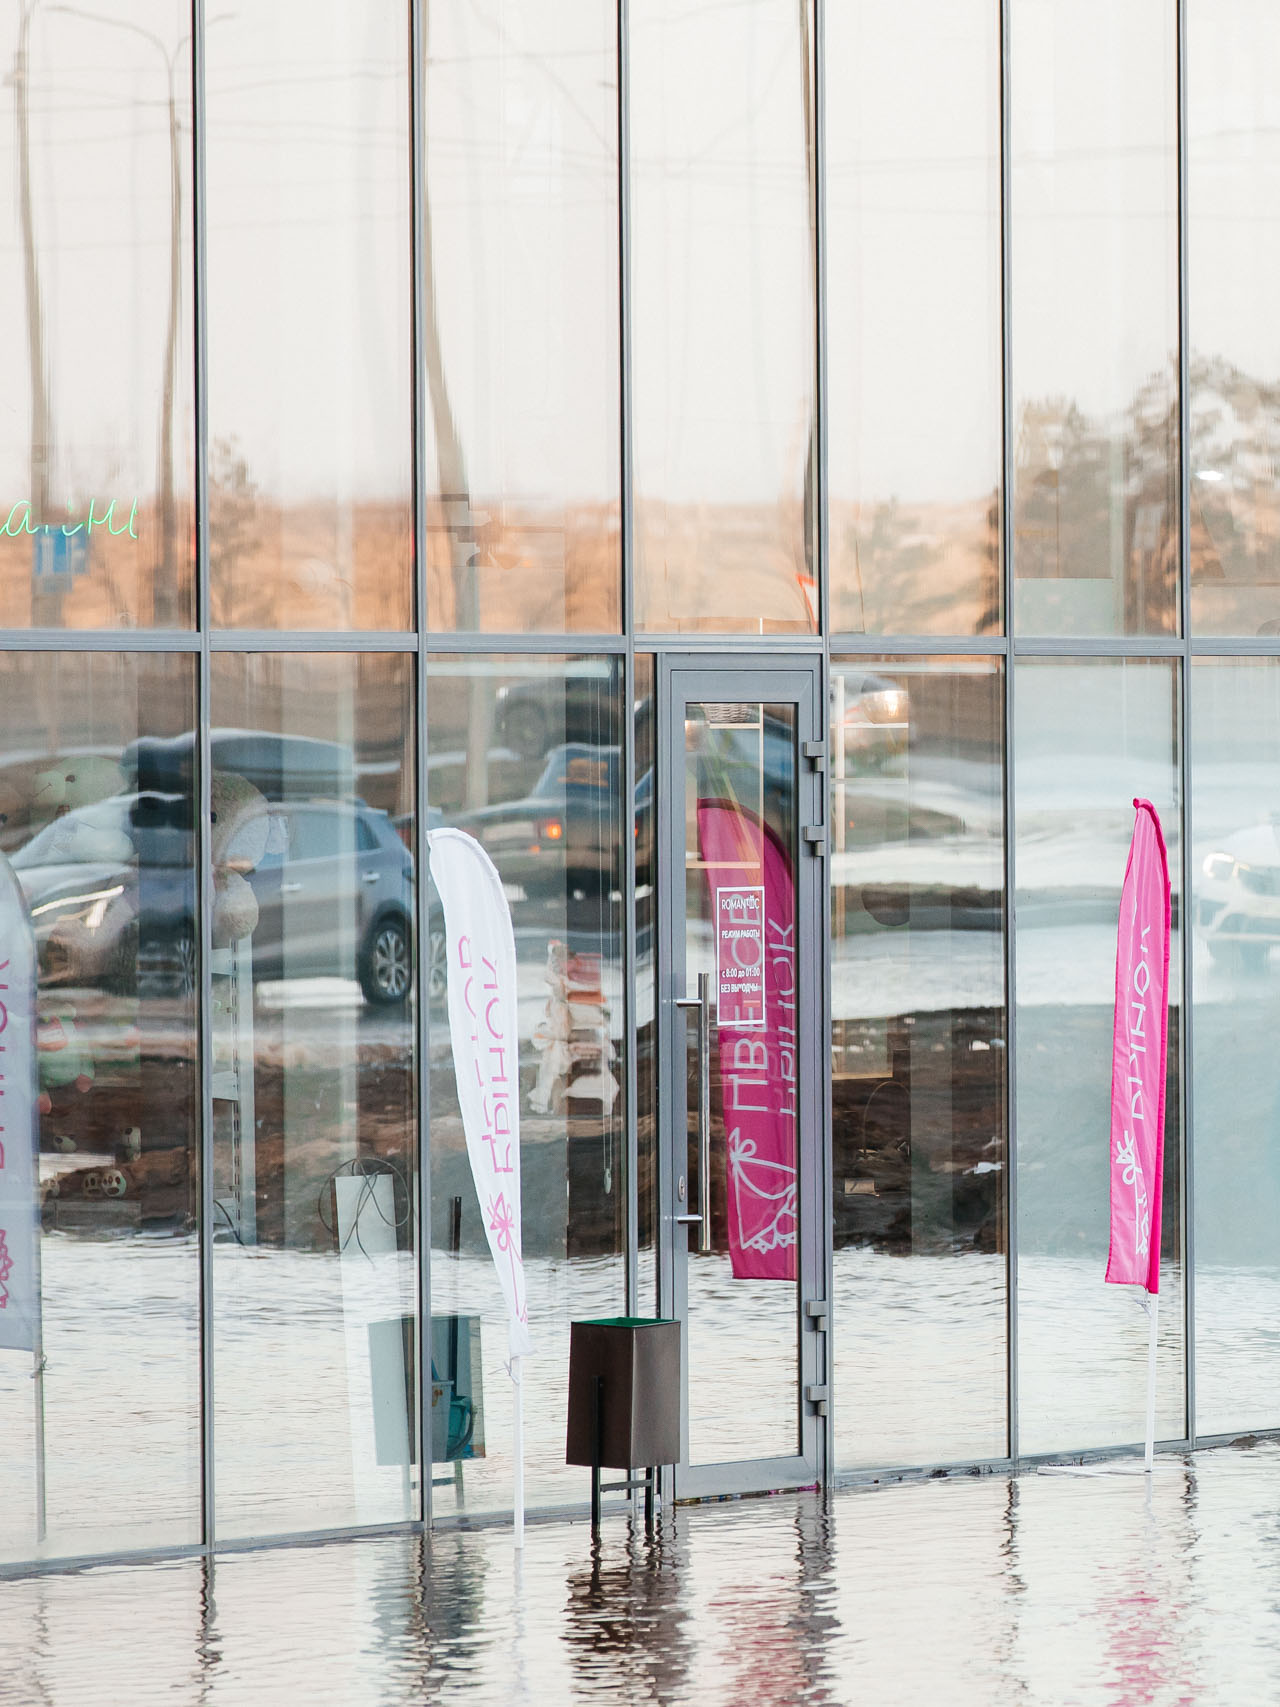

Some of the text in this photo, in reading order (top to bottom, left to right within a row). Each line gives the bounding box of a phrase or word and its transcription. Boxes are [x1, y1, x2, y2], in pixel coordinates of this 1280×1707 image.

[741, 929, 760, 938] РАБОТЫ
[726, 967, 737, 978] 8:00
[738, 970, 745, 978] до
[720, 983, 731, 993] БЕЗ
